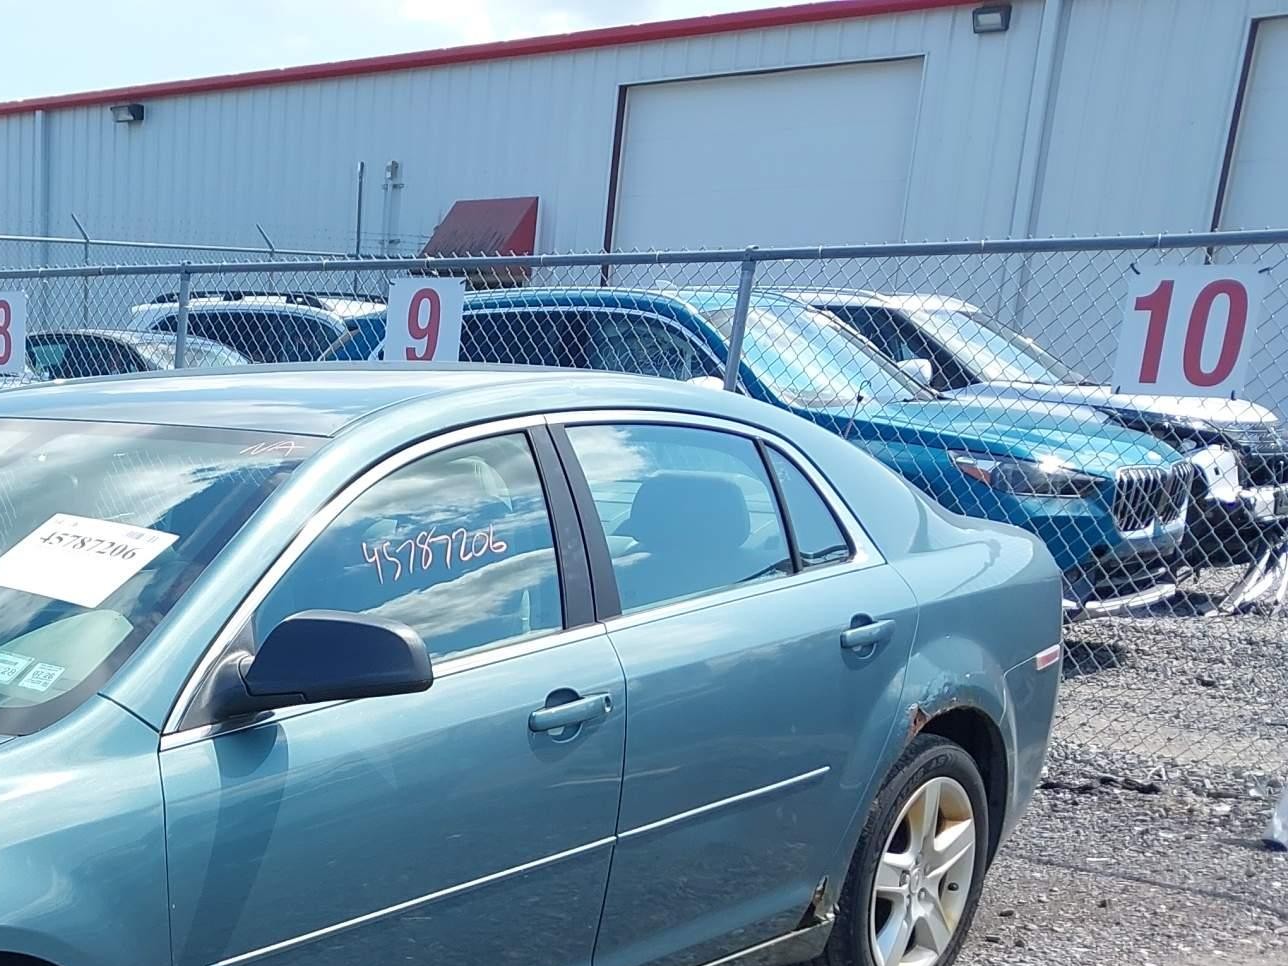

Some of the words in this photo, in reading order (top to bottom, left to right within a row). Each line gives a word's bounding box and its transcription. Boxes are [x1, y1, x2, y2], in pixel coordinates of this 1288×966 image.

[406, 287, 441, 361] 9
[1134, 278, 1248, 388] 10
[40, 531, 143, 561] 45787206
[362, 524, 508, 585] 45787206
